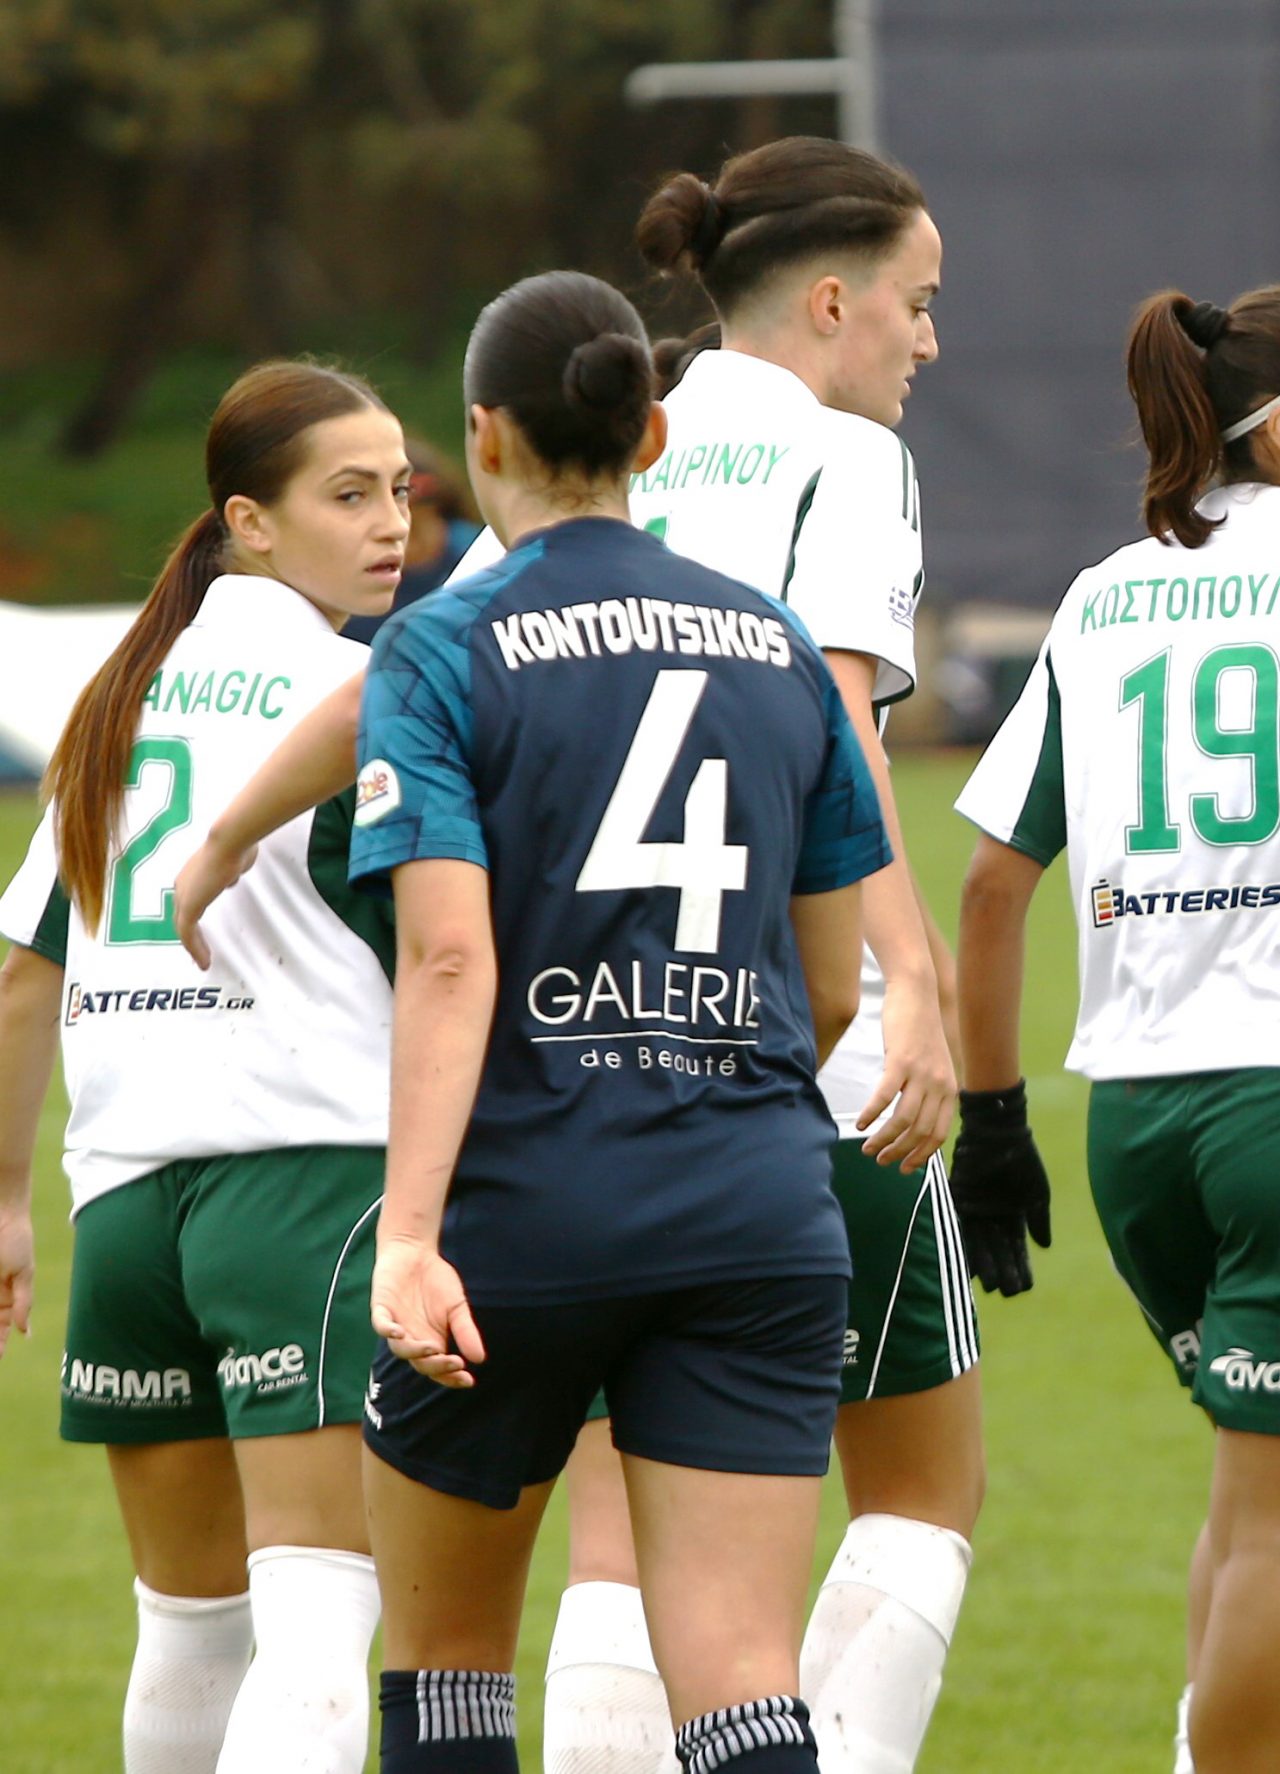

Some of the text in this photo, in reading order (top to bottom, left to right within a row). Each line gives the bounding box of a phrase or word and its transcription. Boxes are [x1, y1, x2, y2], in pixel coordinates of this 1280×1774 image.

[492, 597, 791, 669] KONTOUTSIKOS
[144, 669, 291, 720] ANAGIC
[104, 735, 194, 947] 2
[575, 669, 748, 954] 4
[80, 985, 255, 1014] ATTERIES.GR
[527, 960, 760, 1028] GALERIE
[579, 1045, 737, 1077] de Beauté
[224, 1343, 304, 1387] aance
